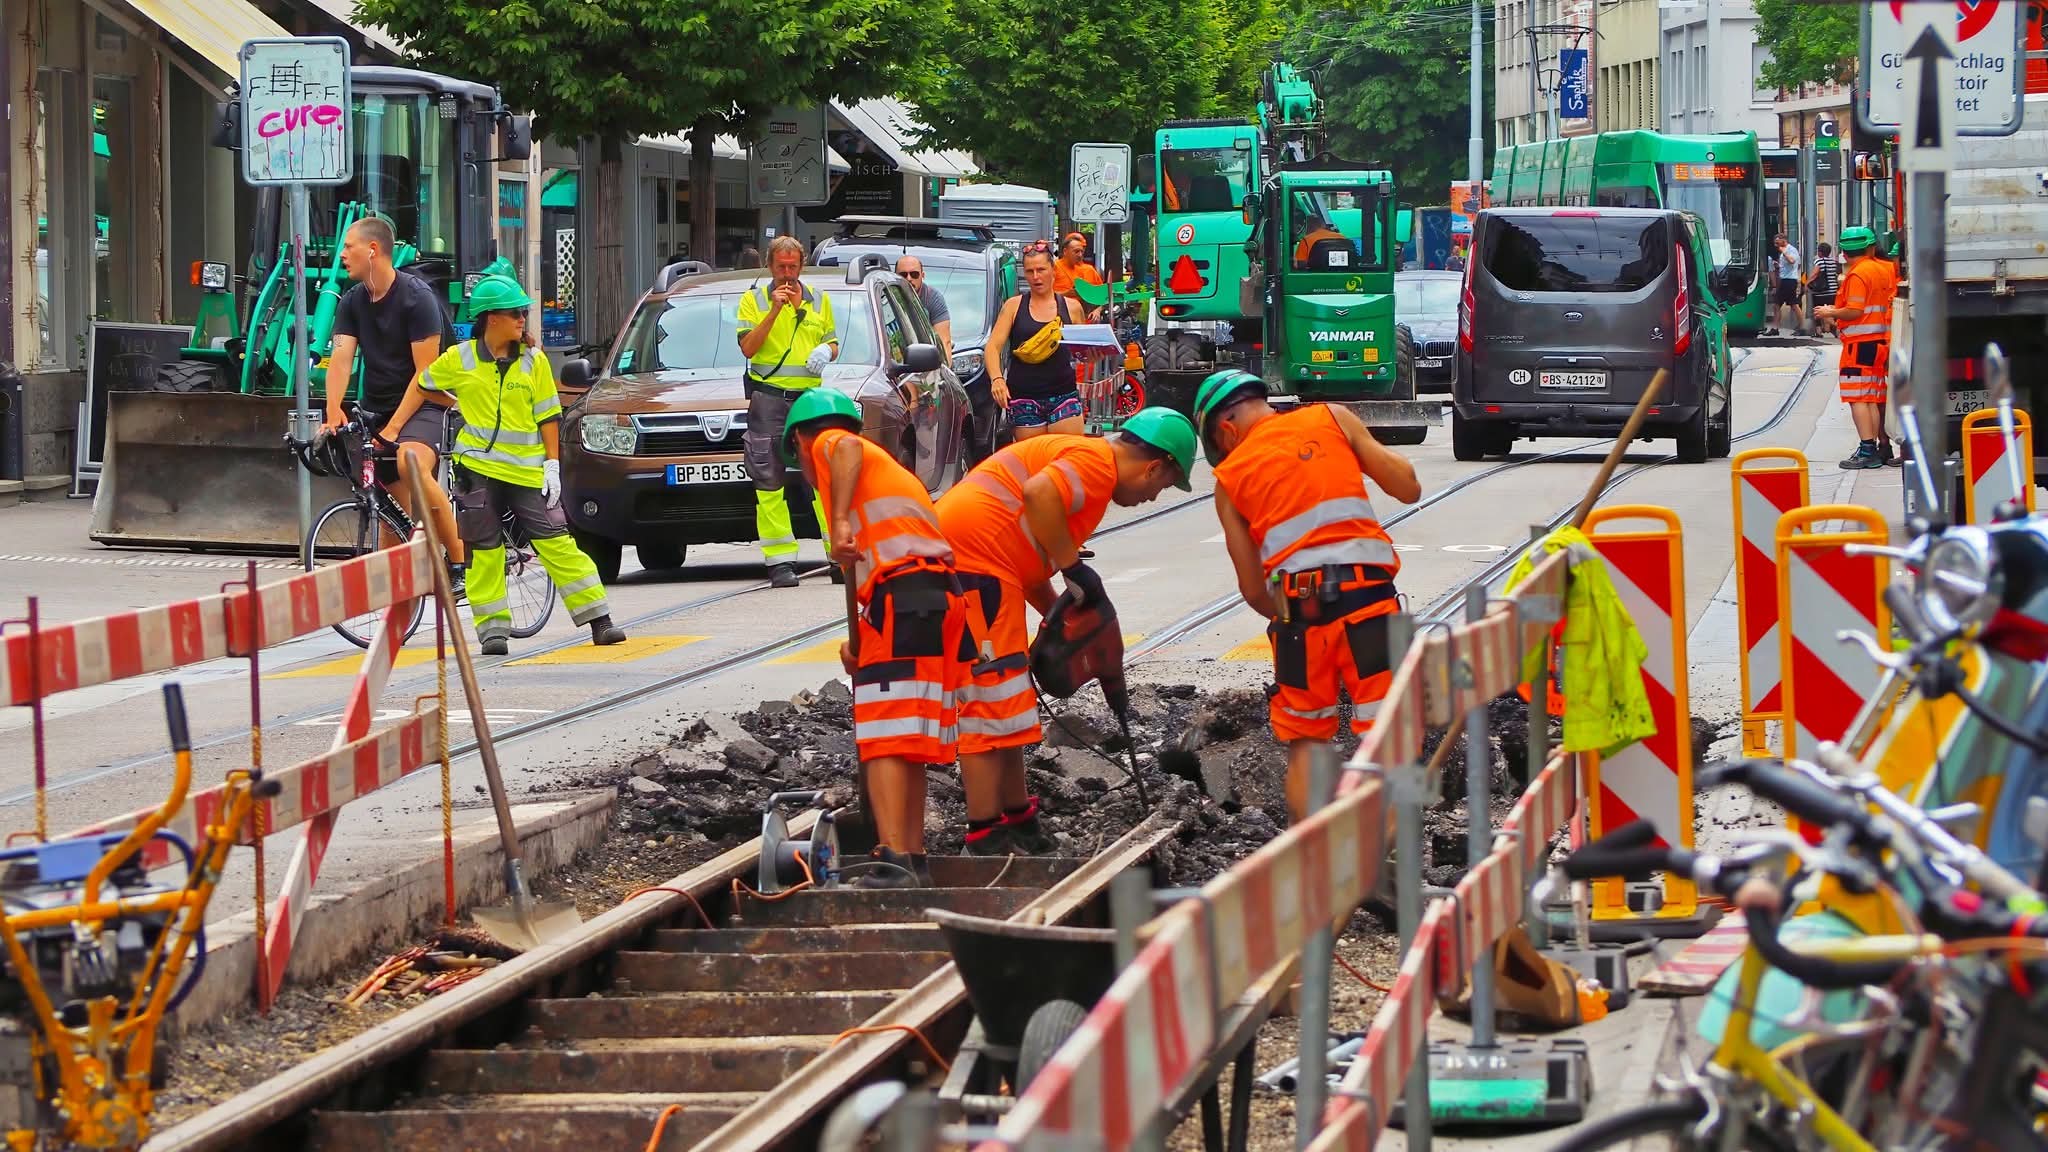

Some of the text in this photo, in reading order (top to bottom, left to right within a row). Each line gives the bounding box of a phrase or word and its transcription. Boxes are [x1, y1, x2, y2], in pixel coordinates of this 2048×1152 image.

[1821, 122, 1833, 137] C
[1181, 229, 1190, 239] 25
[1308, 331, 1375, 341] YANMAR
[1513, 371, 1526, 383] CH
[1963, 392, 1976, 400] BS
